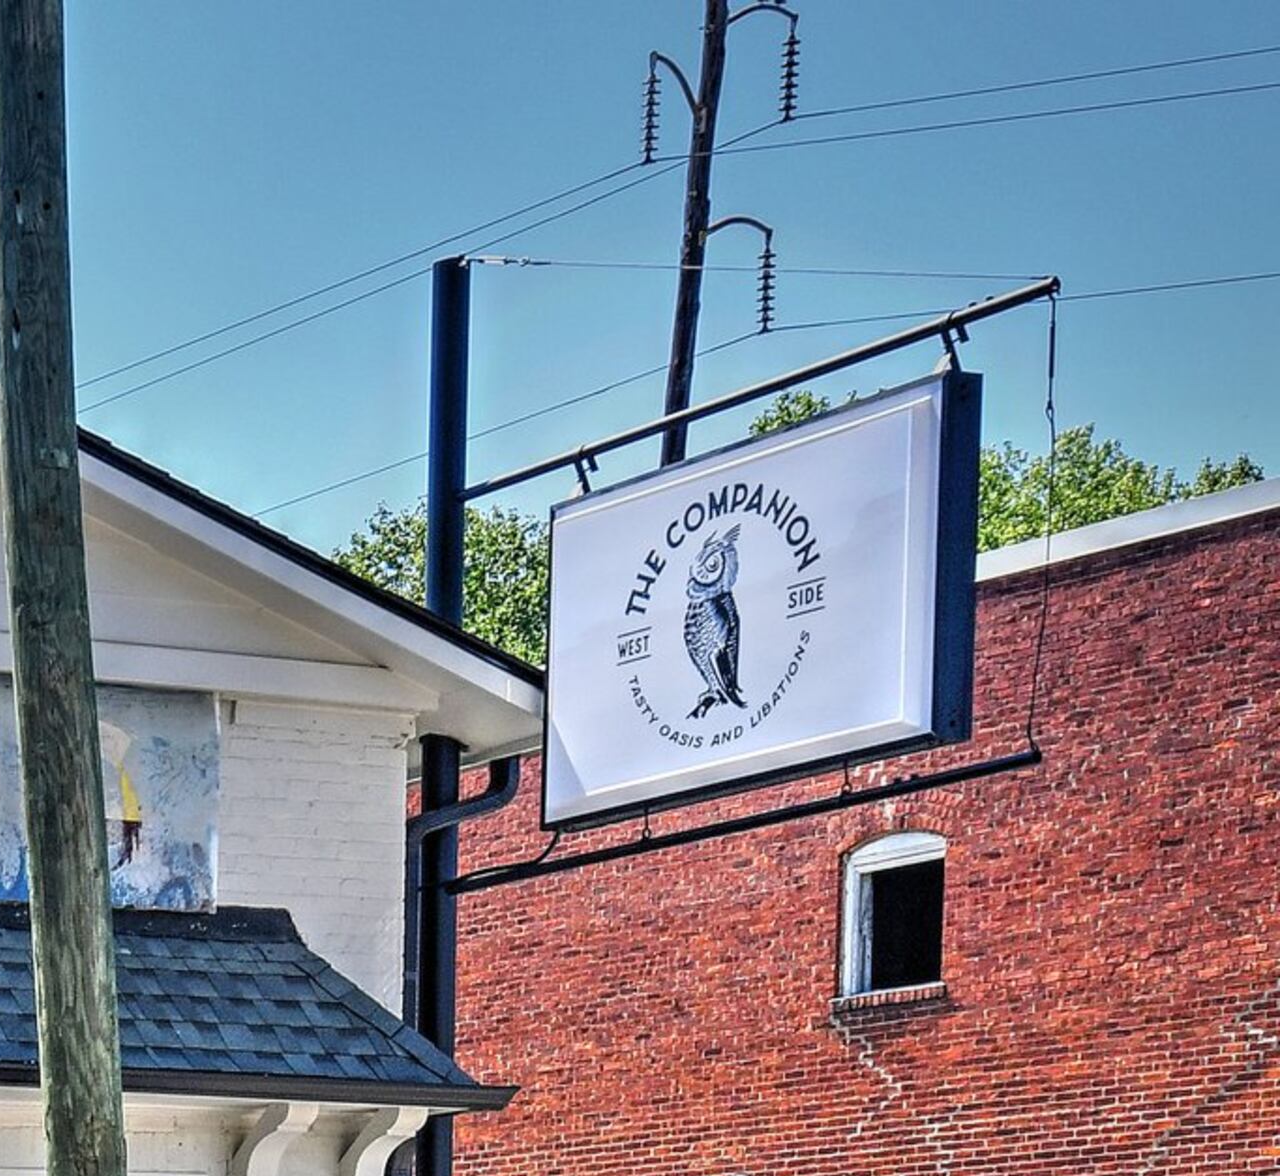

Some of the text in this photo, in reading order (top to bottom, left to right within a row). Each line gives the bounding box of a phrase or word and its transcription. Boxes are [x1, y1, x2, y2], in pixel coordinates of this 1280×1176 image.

[624, 483, 821, 616] THE COMPANION
[787, 583, 825, 609] SIDE
[617, 635, 651, 659] WEST
[629, 630, 811, 749] TASTY OASIS AND LIBATIONS
